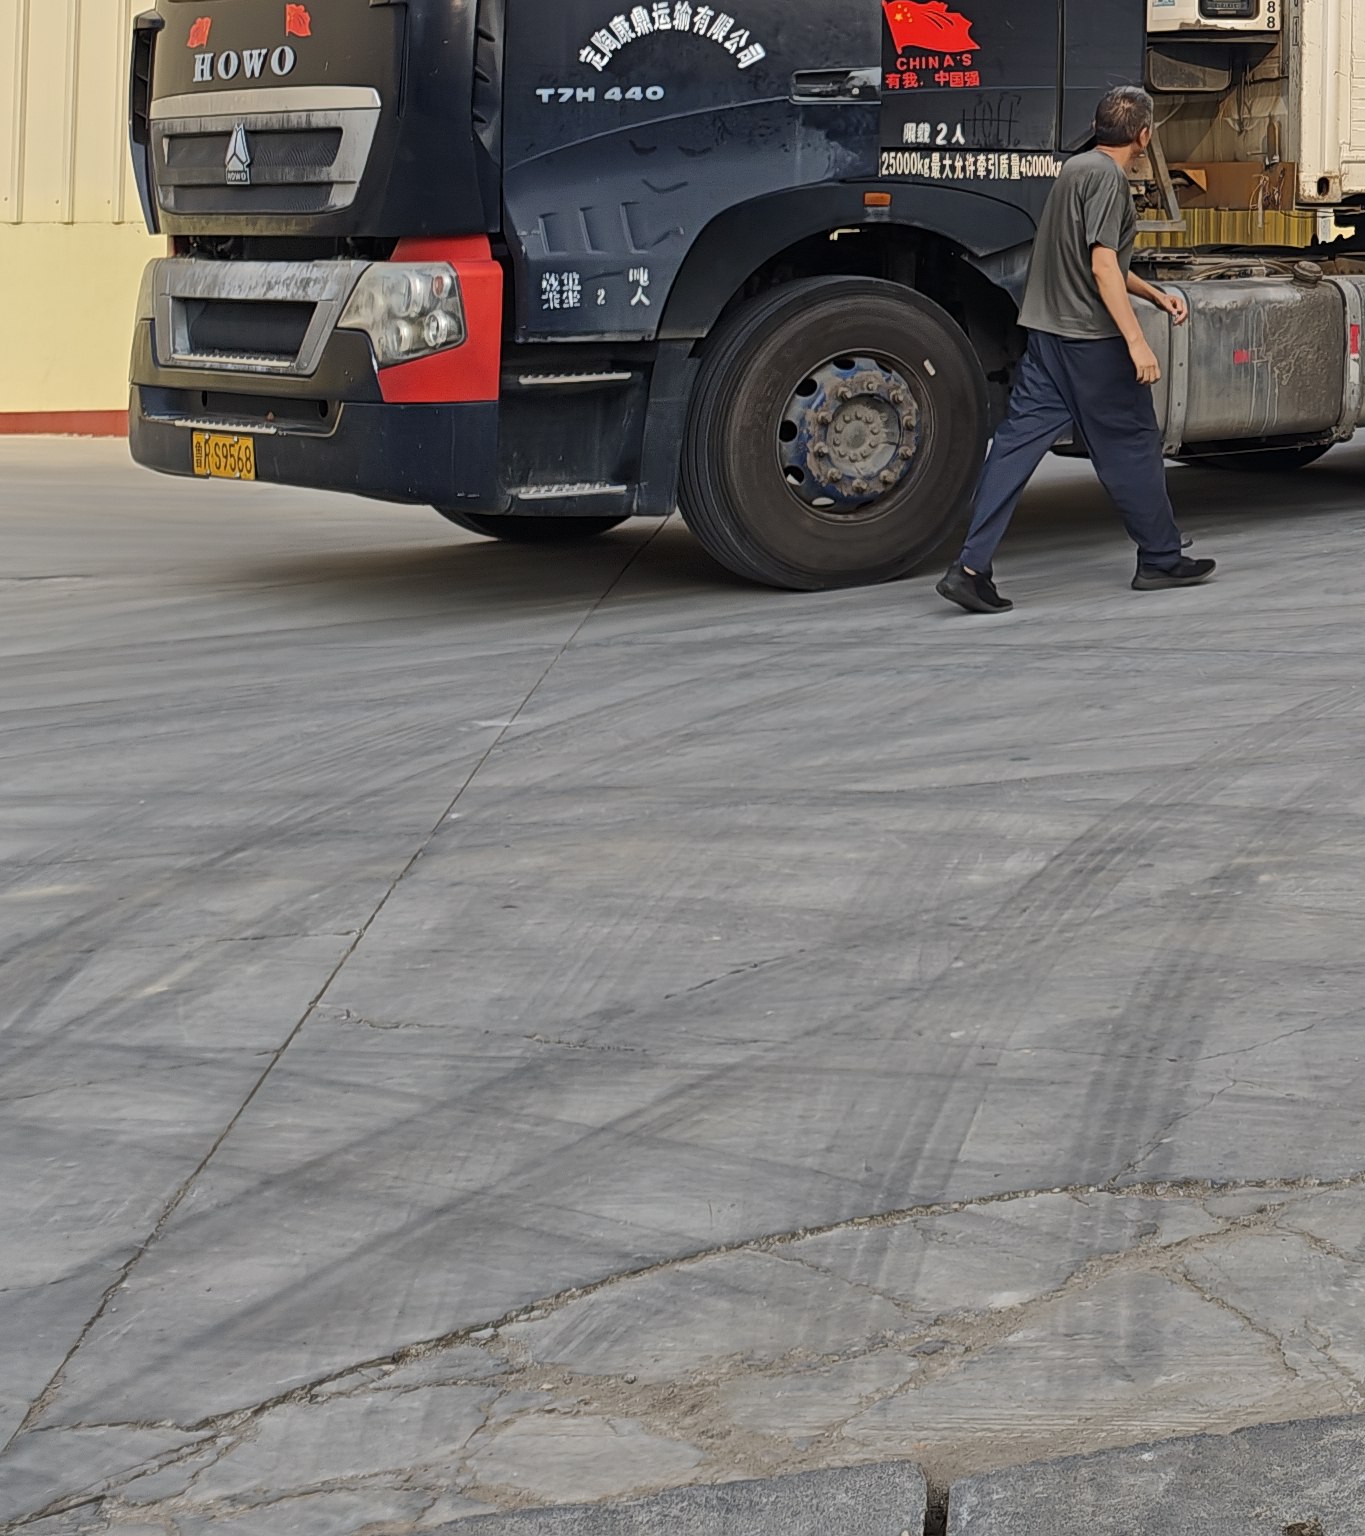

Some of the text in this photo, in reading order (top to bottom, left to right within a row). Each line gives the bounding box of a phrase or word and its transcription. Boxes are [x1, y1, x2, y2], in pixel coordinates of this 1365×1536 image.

[192, 45, 296, 83] HOWO
[896, 53, 973, 71] CHINA'S
[535, 85, 665, 104] T7H 440
[630, 285, 651, 306] 人
